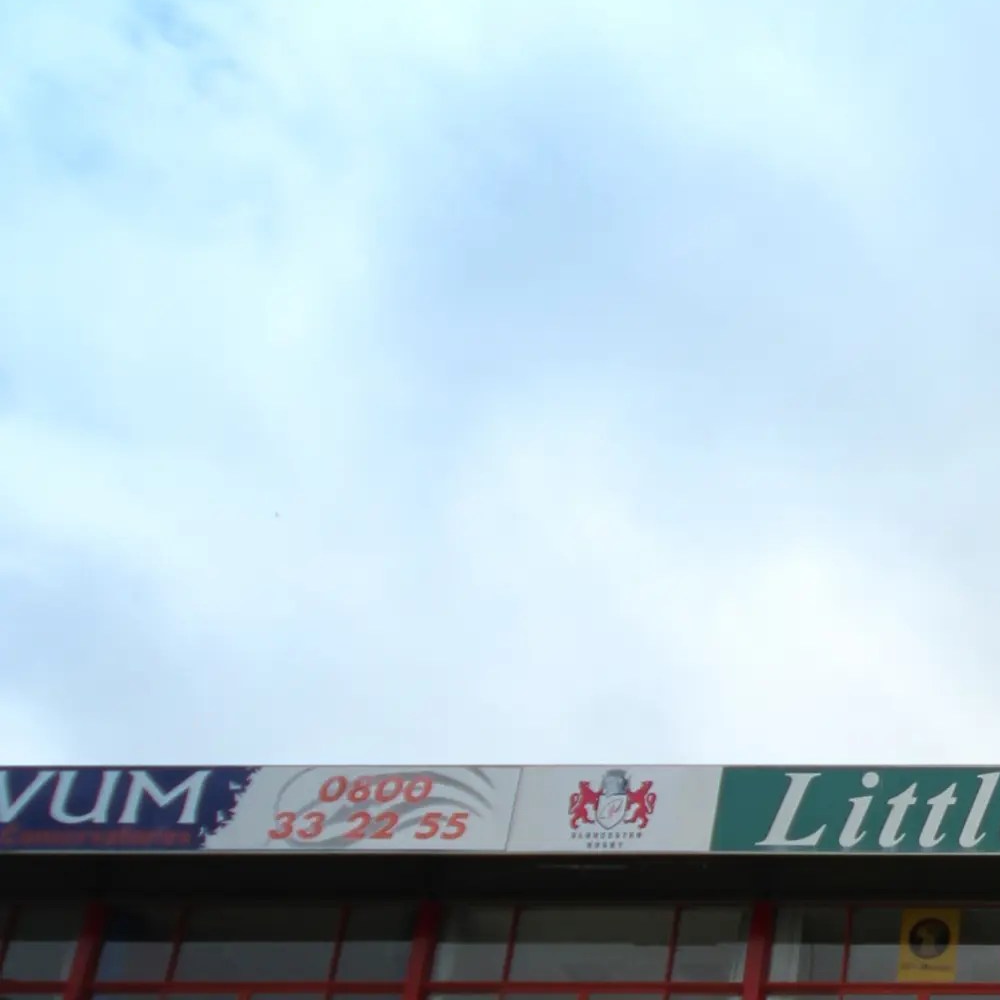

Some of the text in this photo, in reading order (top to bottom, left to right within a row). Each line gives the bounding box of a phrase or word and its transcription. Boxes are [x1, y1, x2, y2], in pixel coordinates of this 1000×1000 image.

[268, 811, 469, 840] 33 22 55
